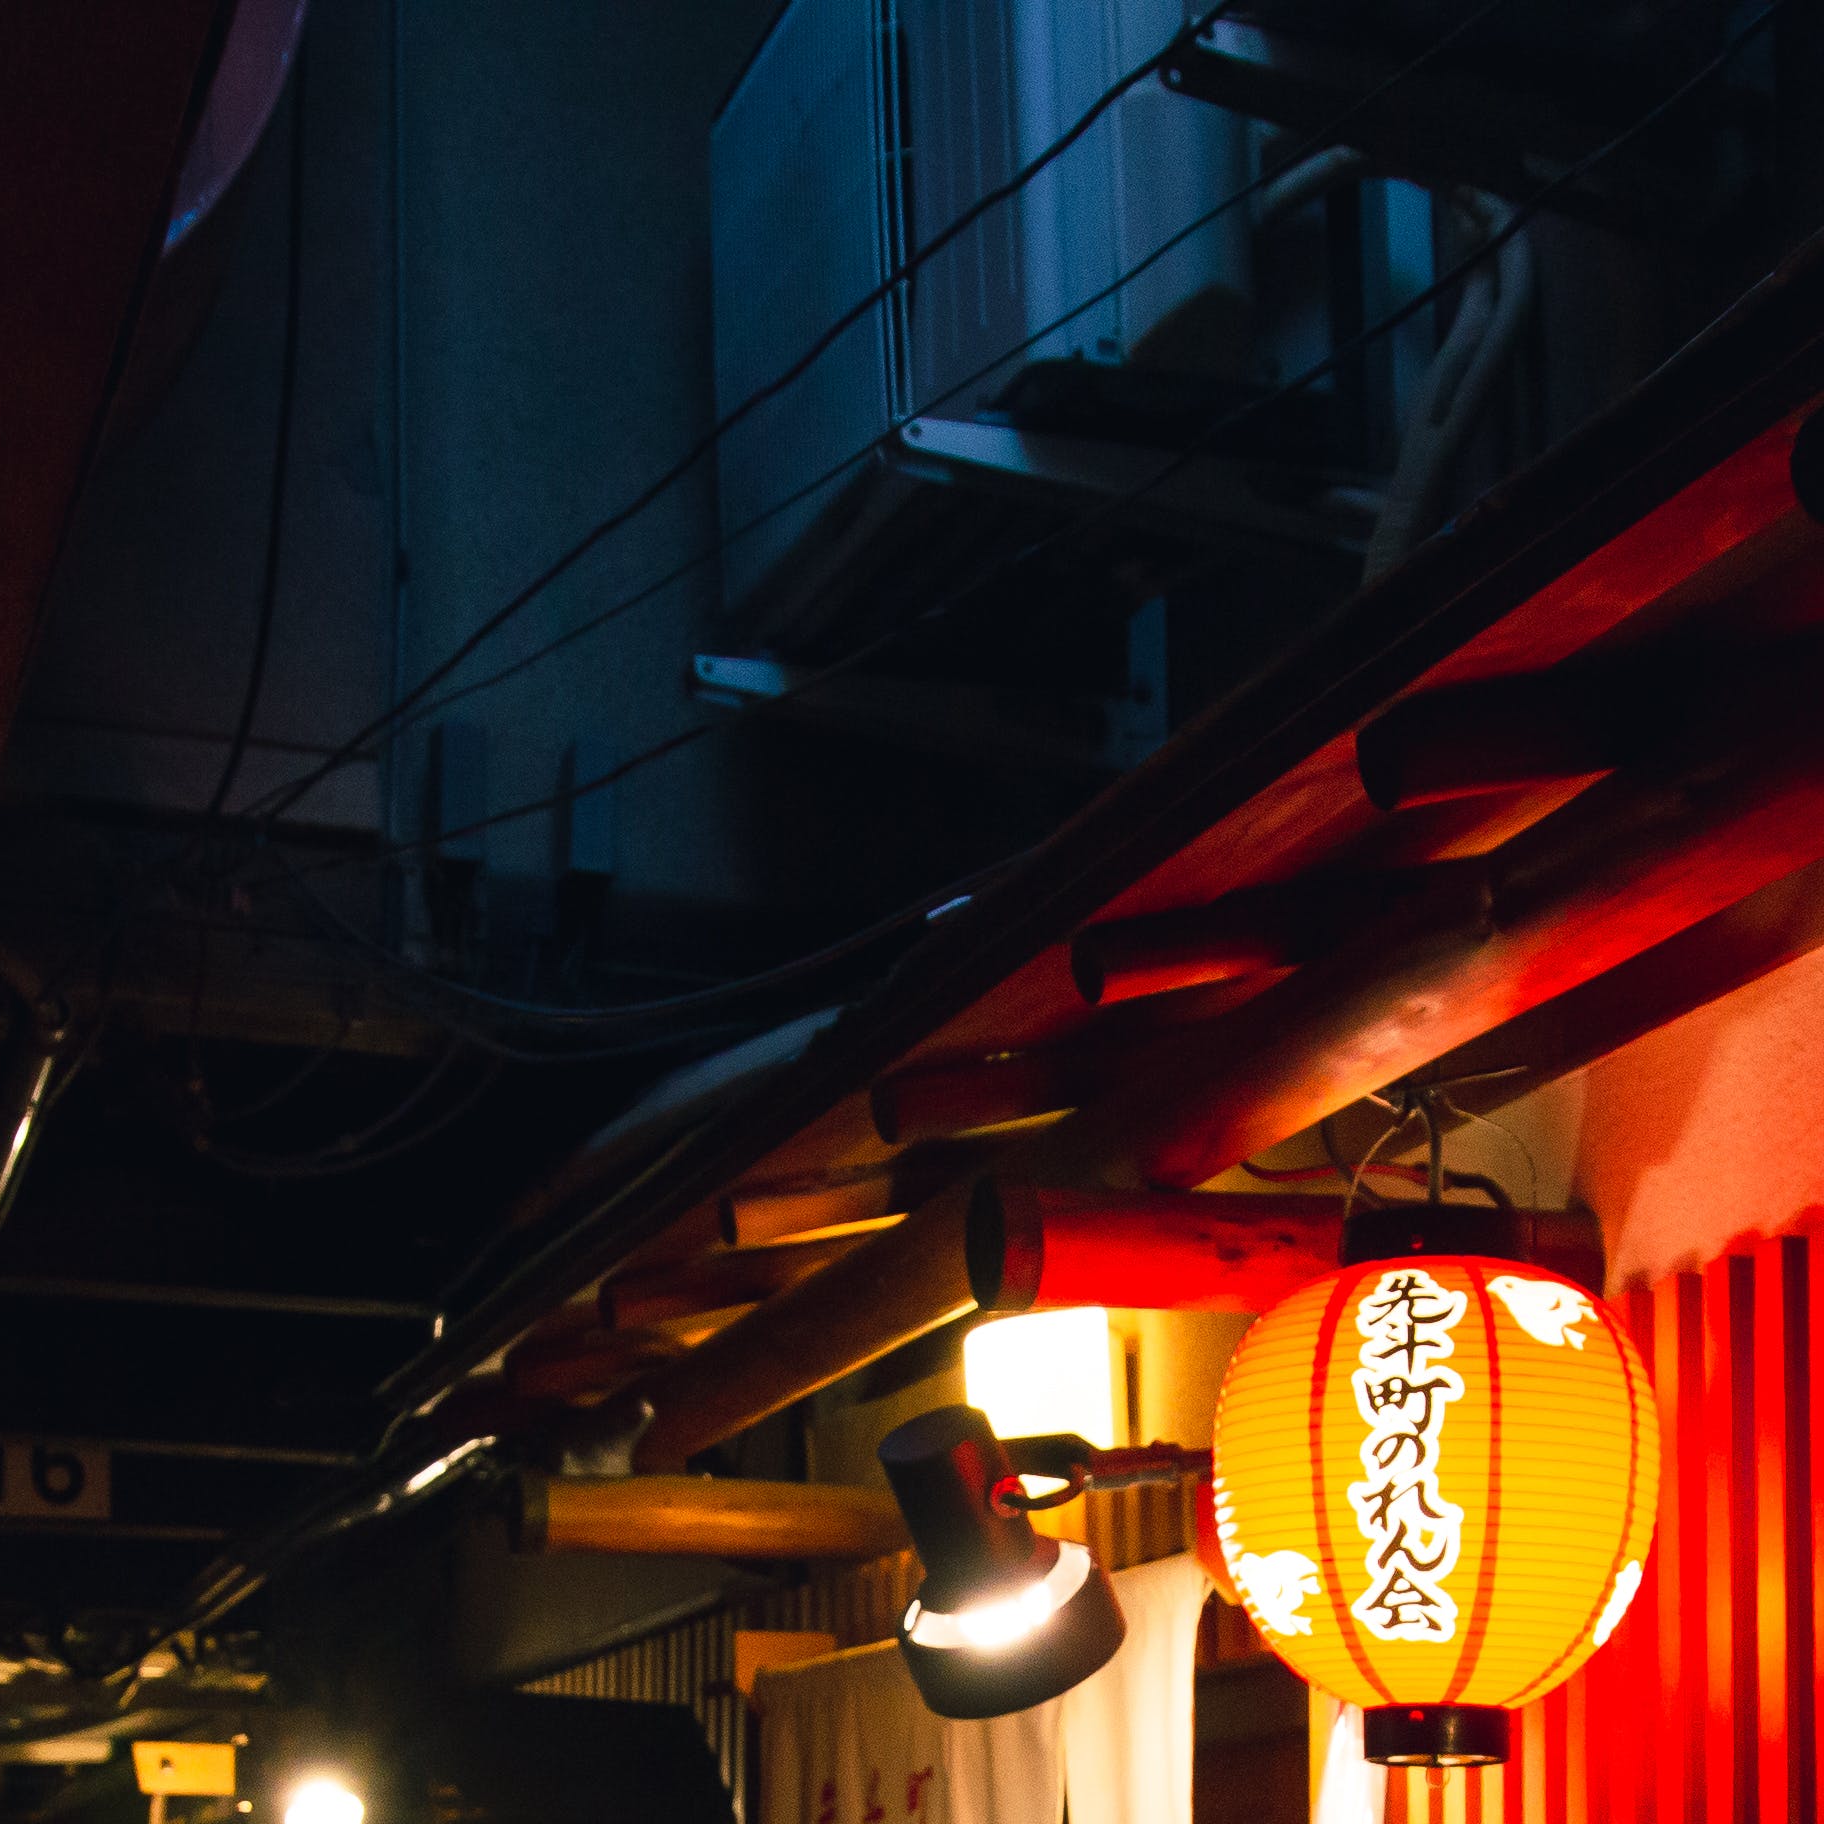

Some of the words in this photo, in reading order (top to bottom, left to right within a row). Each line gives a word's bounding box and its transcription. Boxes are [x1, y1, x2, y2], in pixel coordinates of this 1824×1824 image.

[1363, 1274, 1453, 1633] 先斗町のれん会
